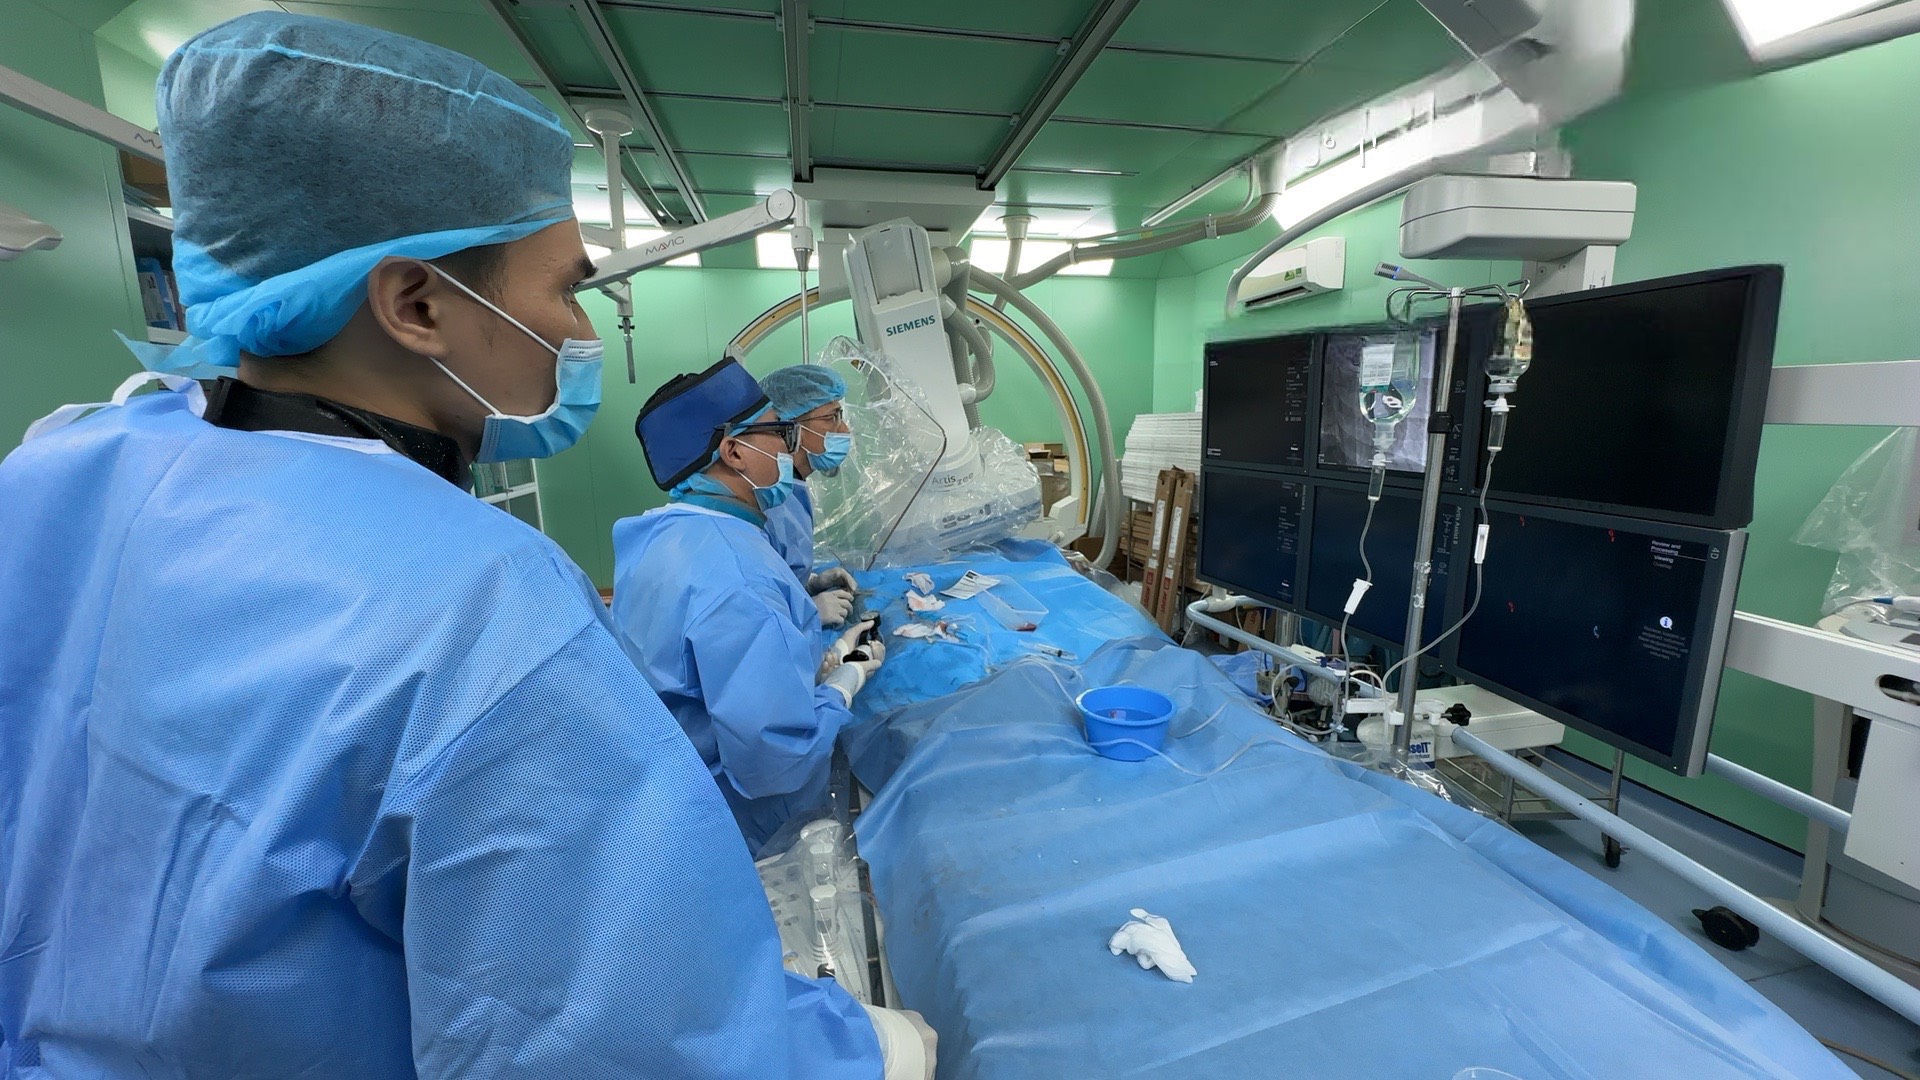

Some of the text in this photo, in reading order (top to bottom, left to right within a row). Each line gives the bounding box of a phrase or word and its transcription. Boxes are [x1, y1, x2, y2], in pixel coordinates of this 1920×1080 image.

[645, 236, 685, 255] MAVIG
[886, 315, 936, 337] SIEMENS
[932, 472, 974, 486] Artis zee
[1710, 547, 1720, 560] 4D
